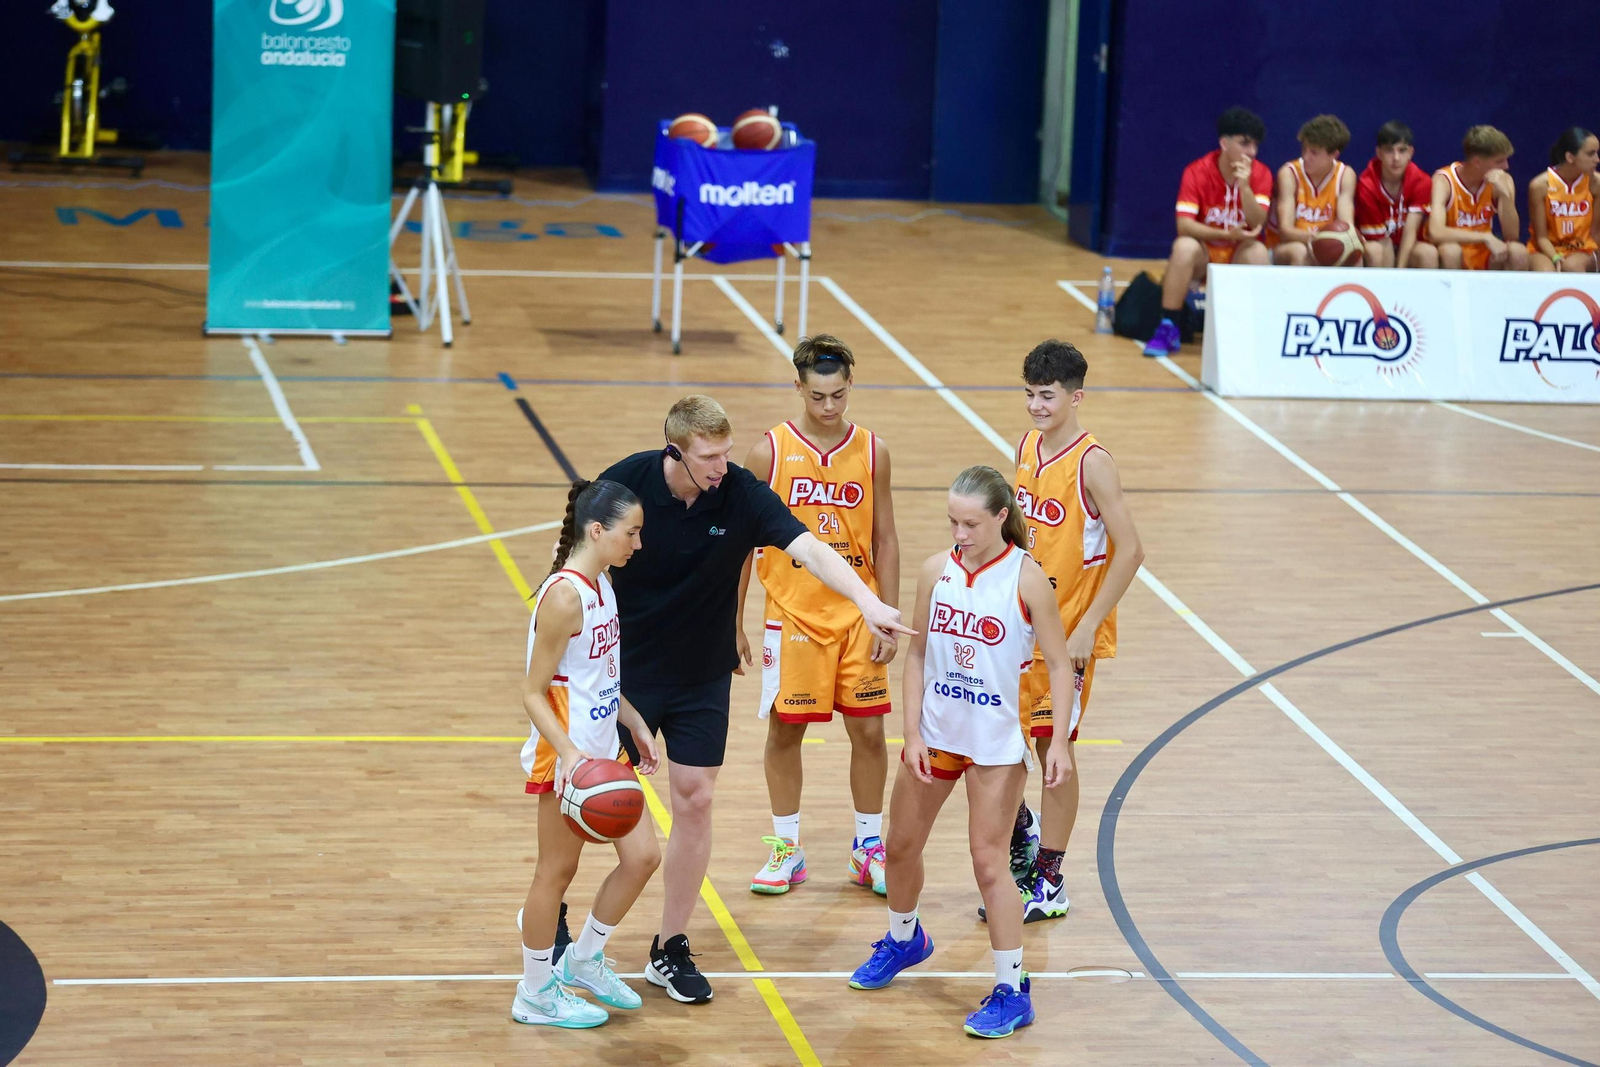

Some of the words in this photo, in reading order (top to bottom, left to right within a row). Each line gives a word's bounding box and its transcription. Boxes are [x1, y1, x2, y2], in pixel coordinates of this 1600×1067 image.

[261, 32, 351, 51] baloncesto
[699, 182, 795, 207] molten
[1281, 312, 1412, 362] PALO
[1294, 323, 1312, 337] EL
[1513, 328, 1530, 342] EL
[788, 477, 864, 509] PALO
[797, 483, 809, 493] EL
[818, 512, 840, 534] 24
[930, 602, 1006, 646] PALO
[938, 609, 948, 621] EL
[607, 654, 617, 678] 6
[953, 642, 976, 669] 32
[946, 671, 984, 685] cementos
[784, 698, 817, 706] cosmos
[934, 681, 1002, 707] cosmos
